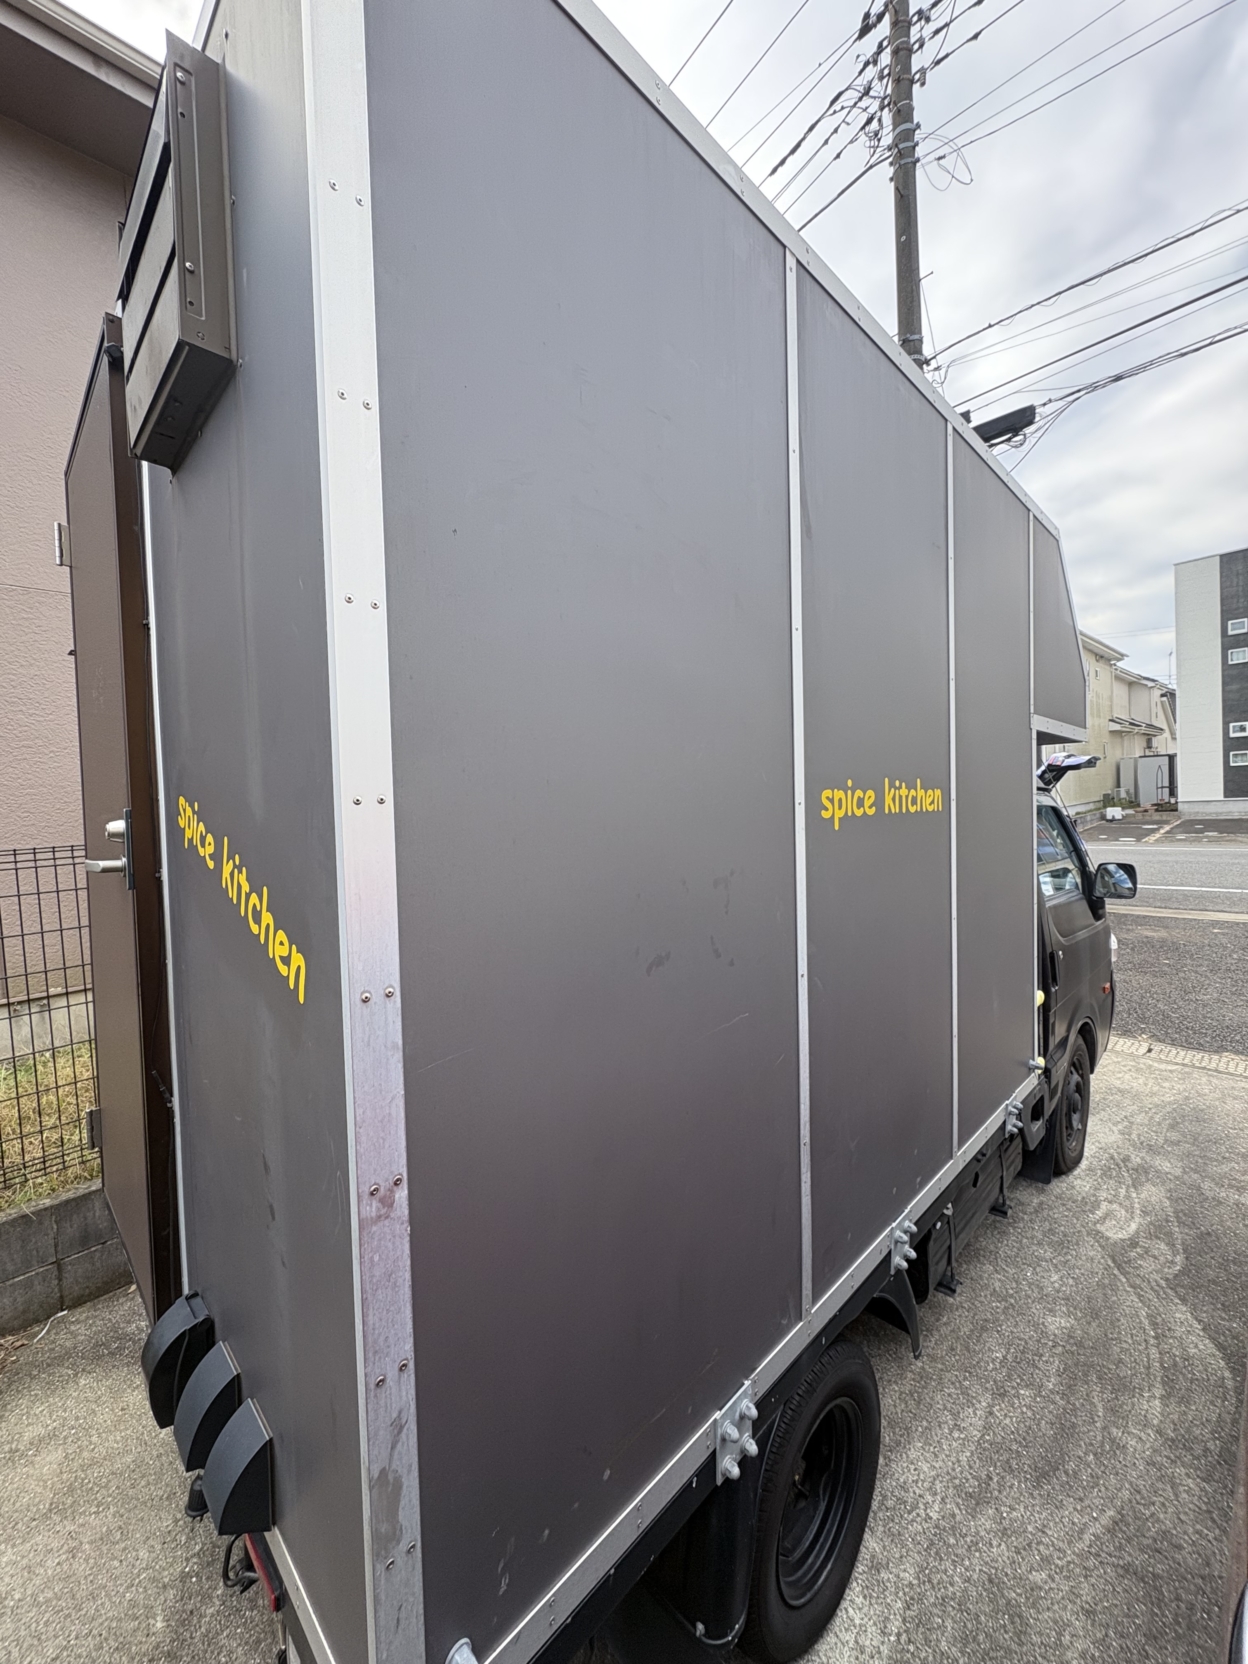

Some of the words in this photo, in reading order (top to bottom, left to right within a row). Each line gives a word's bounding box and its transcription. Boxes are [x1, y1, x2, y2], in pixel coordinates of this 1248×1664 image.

[820, 779, 876, 831] spice
[884, 777, 943, 814] kitchen
[177, 795, 216, 870] spice
[221, 836, 307, 1005] kitchen
